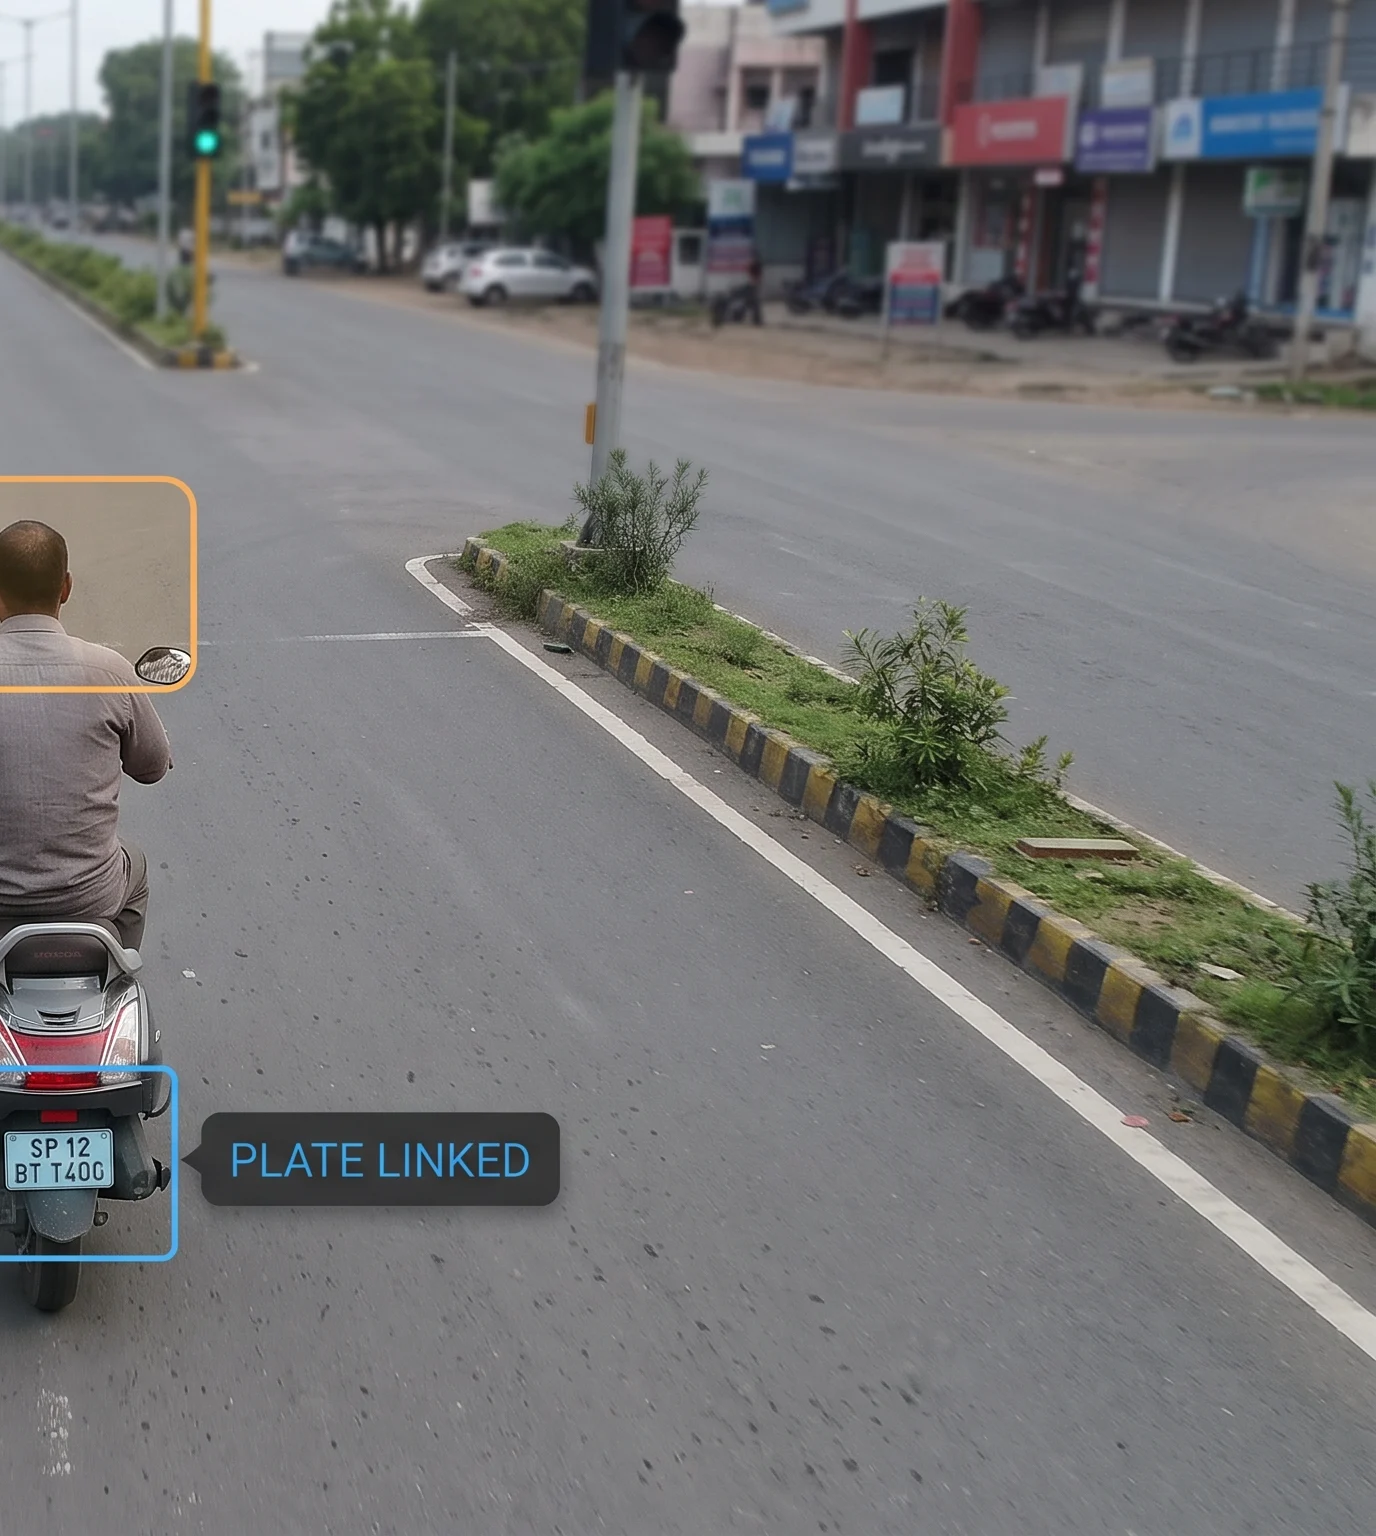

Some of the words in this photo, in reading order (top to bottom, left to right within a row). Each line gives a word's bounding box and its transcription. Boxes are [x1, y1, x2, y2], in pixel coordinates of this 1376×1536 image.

[30, 1137, 58, 1159] SP
[66, 1136, 91, 1158] 12
[15, 1162, 42, 1184] BT
